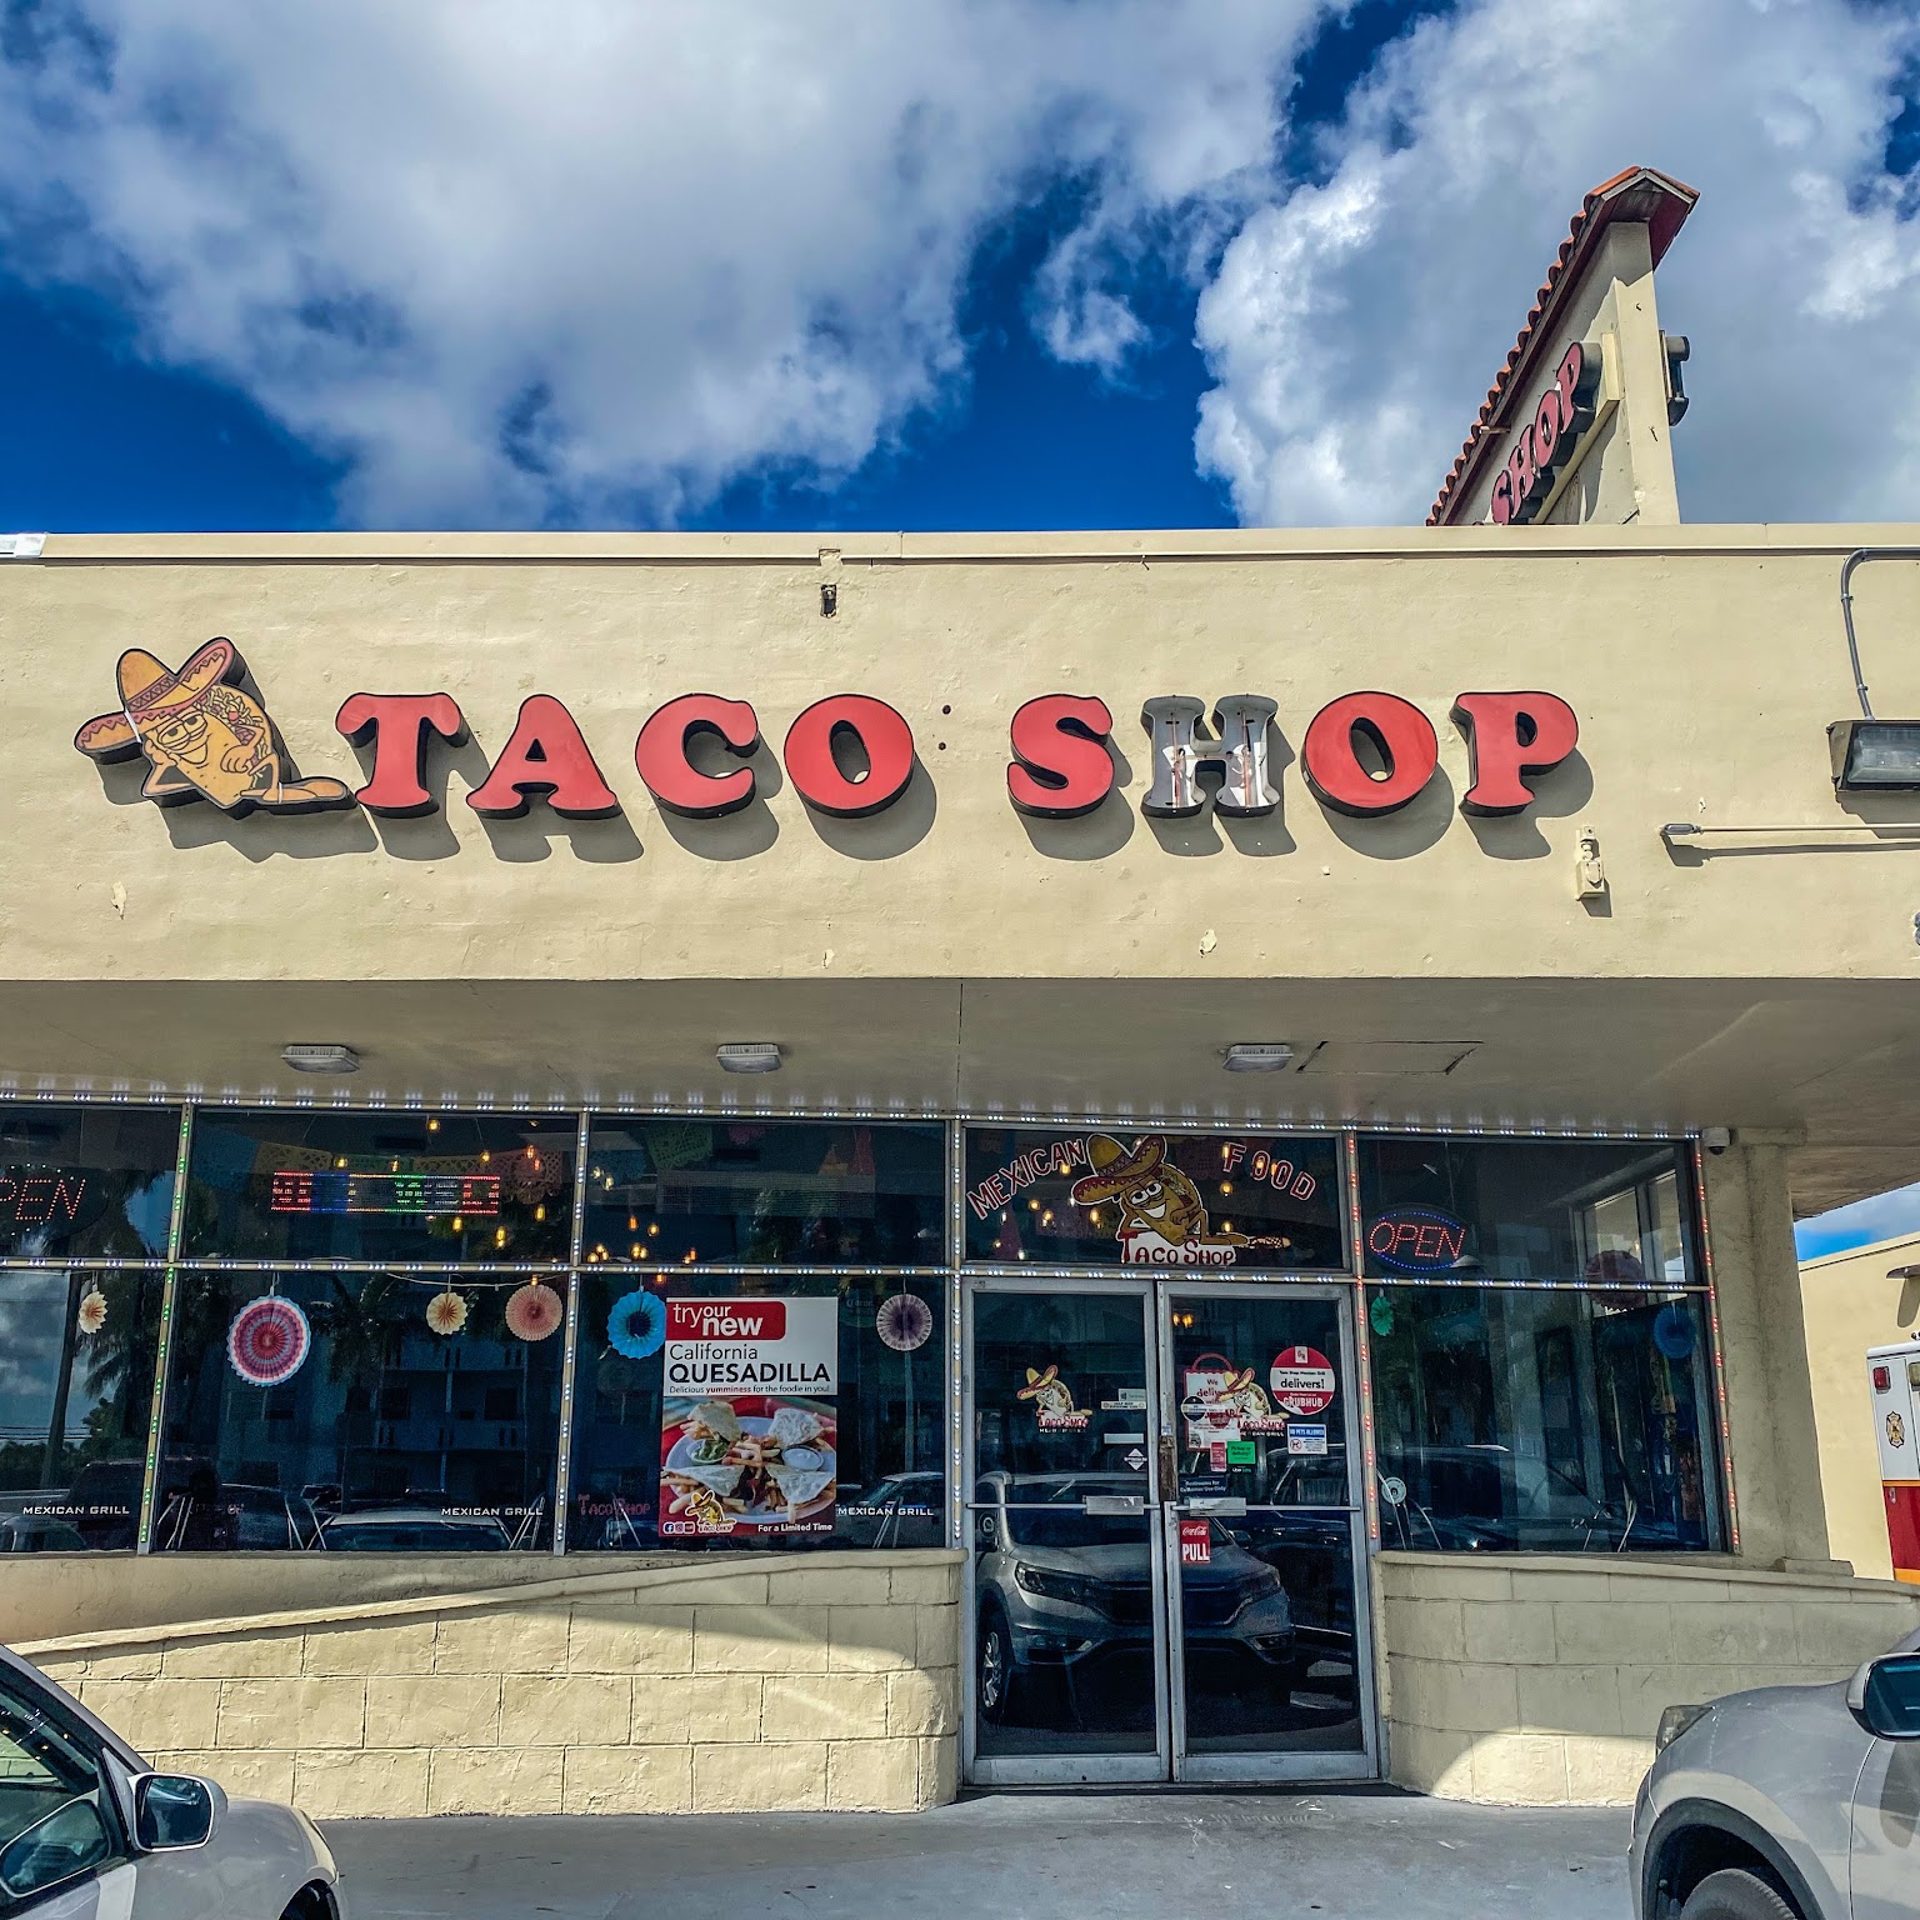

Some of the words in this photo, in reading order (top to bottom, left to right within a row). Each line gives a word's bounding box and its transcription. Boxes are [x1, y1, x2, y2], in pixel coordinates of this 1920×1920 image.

[1491, 342, 1583, 525] SHOP
[335, 692, 915, 817] TACO
[1007, 691, 1579, 817] SHOP
[966, 1138, 1087, 1220] MEXICAN
[1223, 1142, 1316, 1201] FOOD
[1117, 1229, 1178, 1264] TACO
[1184, 1241, 1235, 1264] SHOP
[1369, 1221, 1465, 1259] OPEN
[673, 1303, 703, 1328] try
[703, 1306, 732, 1317] our
[702, 1317, 763, 1336] new
[669, 1343, 758, 1360] California
[669, 1363, 831, 1383] QUESADILLA
[669, 1385, 705, 1393] Delicious
[753, 1385, 766, 1393] for
[767, 1385, 778, 1393] the
[779, 1385, 803, 1393] foodie
[804, 1385, 812, 1393] in
[1280, 1378, 1325, 1389] delivers!
[22, 1506, 84, 1515] MEXICAN
[89, 1506, 130, 1515] GRILL
[441, 1507, 500, 1516] MEXICAN
[504, 1507, 543, 1516] GRILL
[578, 1494, 613, 1515] TACO
[838, 1507, 894, 1516] MEXICAN
[898, 1507, 934, 1516] GRILL
[758, 1524, 772, 1532] For
[781, 1523, 811, 1532] Limited
[812, 1523, 833, 1531] Time
[1182, 1543, 1211, 1560] PULL
